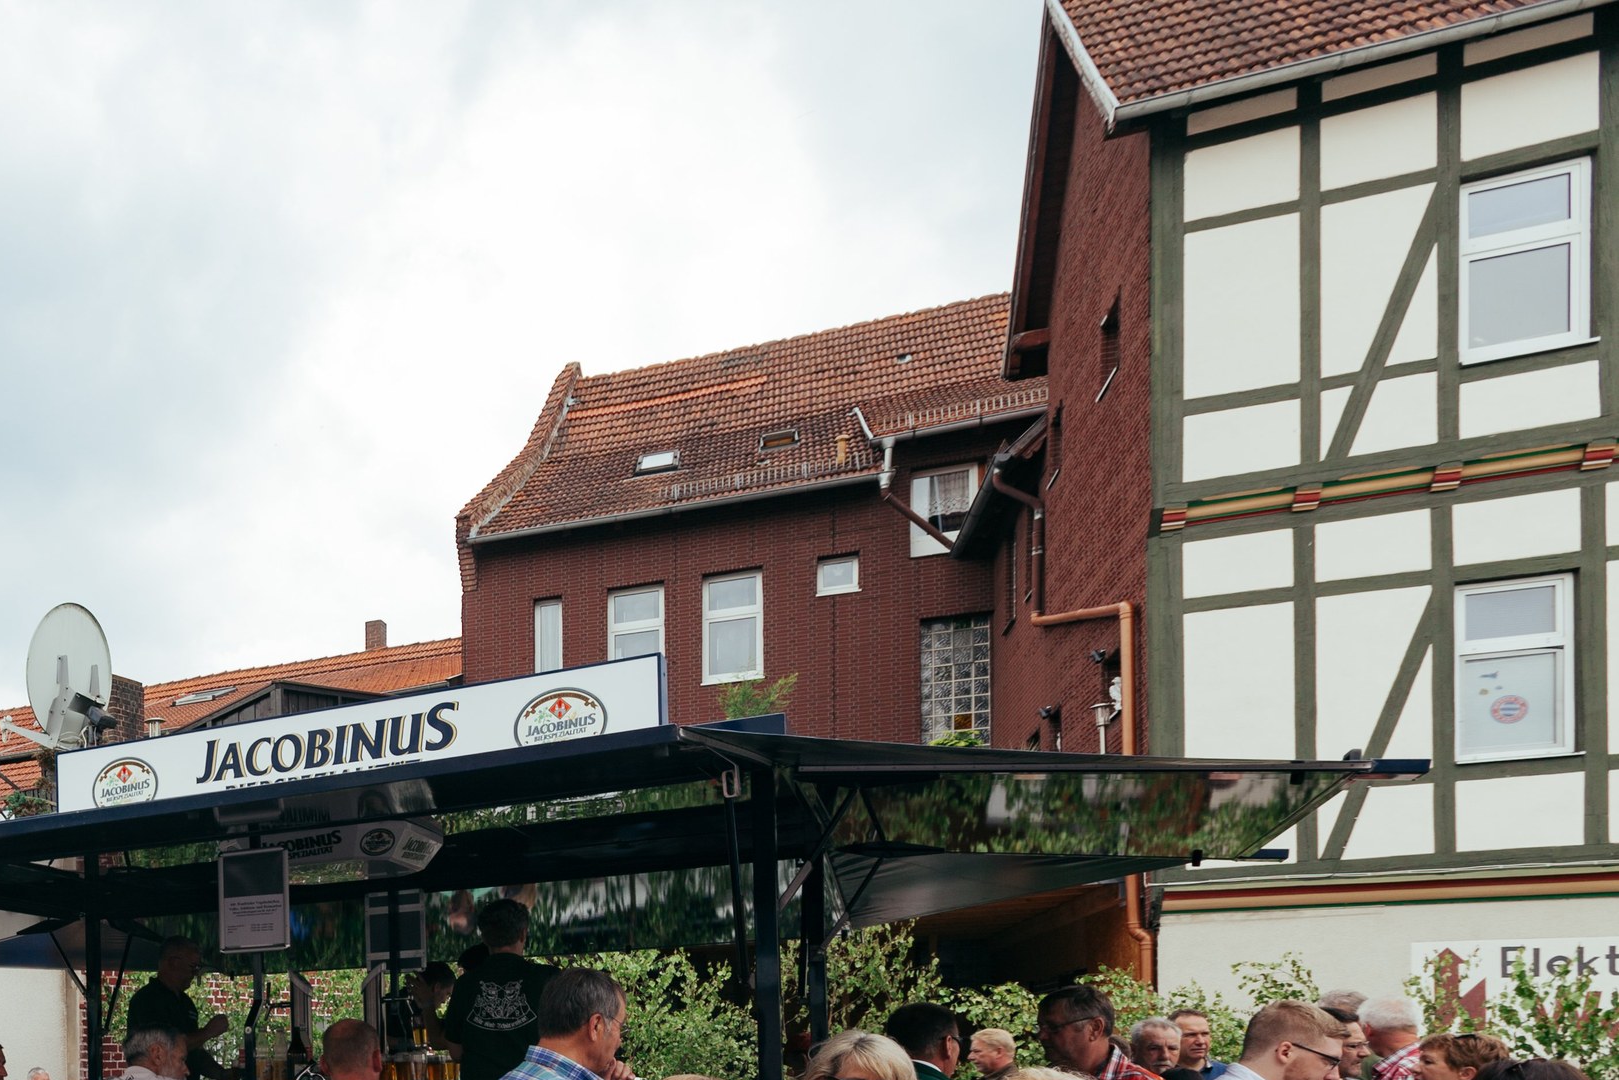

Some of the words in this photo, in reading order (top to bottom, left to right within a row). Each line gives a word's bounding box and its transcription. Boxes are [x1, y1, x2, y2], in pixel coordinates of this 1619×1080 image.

[525, 713, 596, 738] JACOBINUS
[196, 701, 460, 784] JACOBINUS
[100, 778, 150, 798] JACOBINUS
